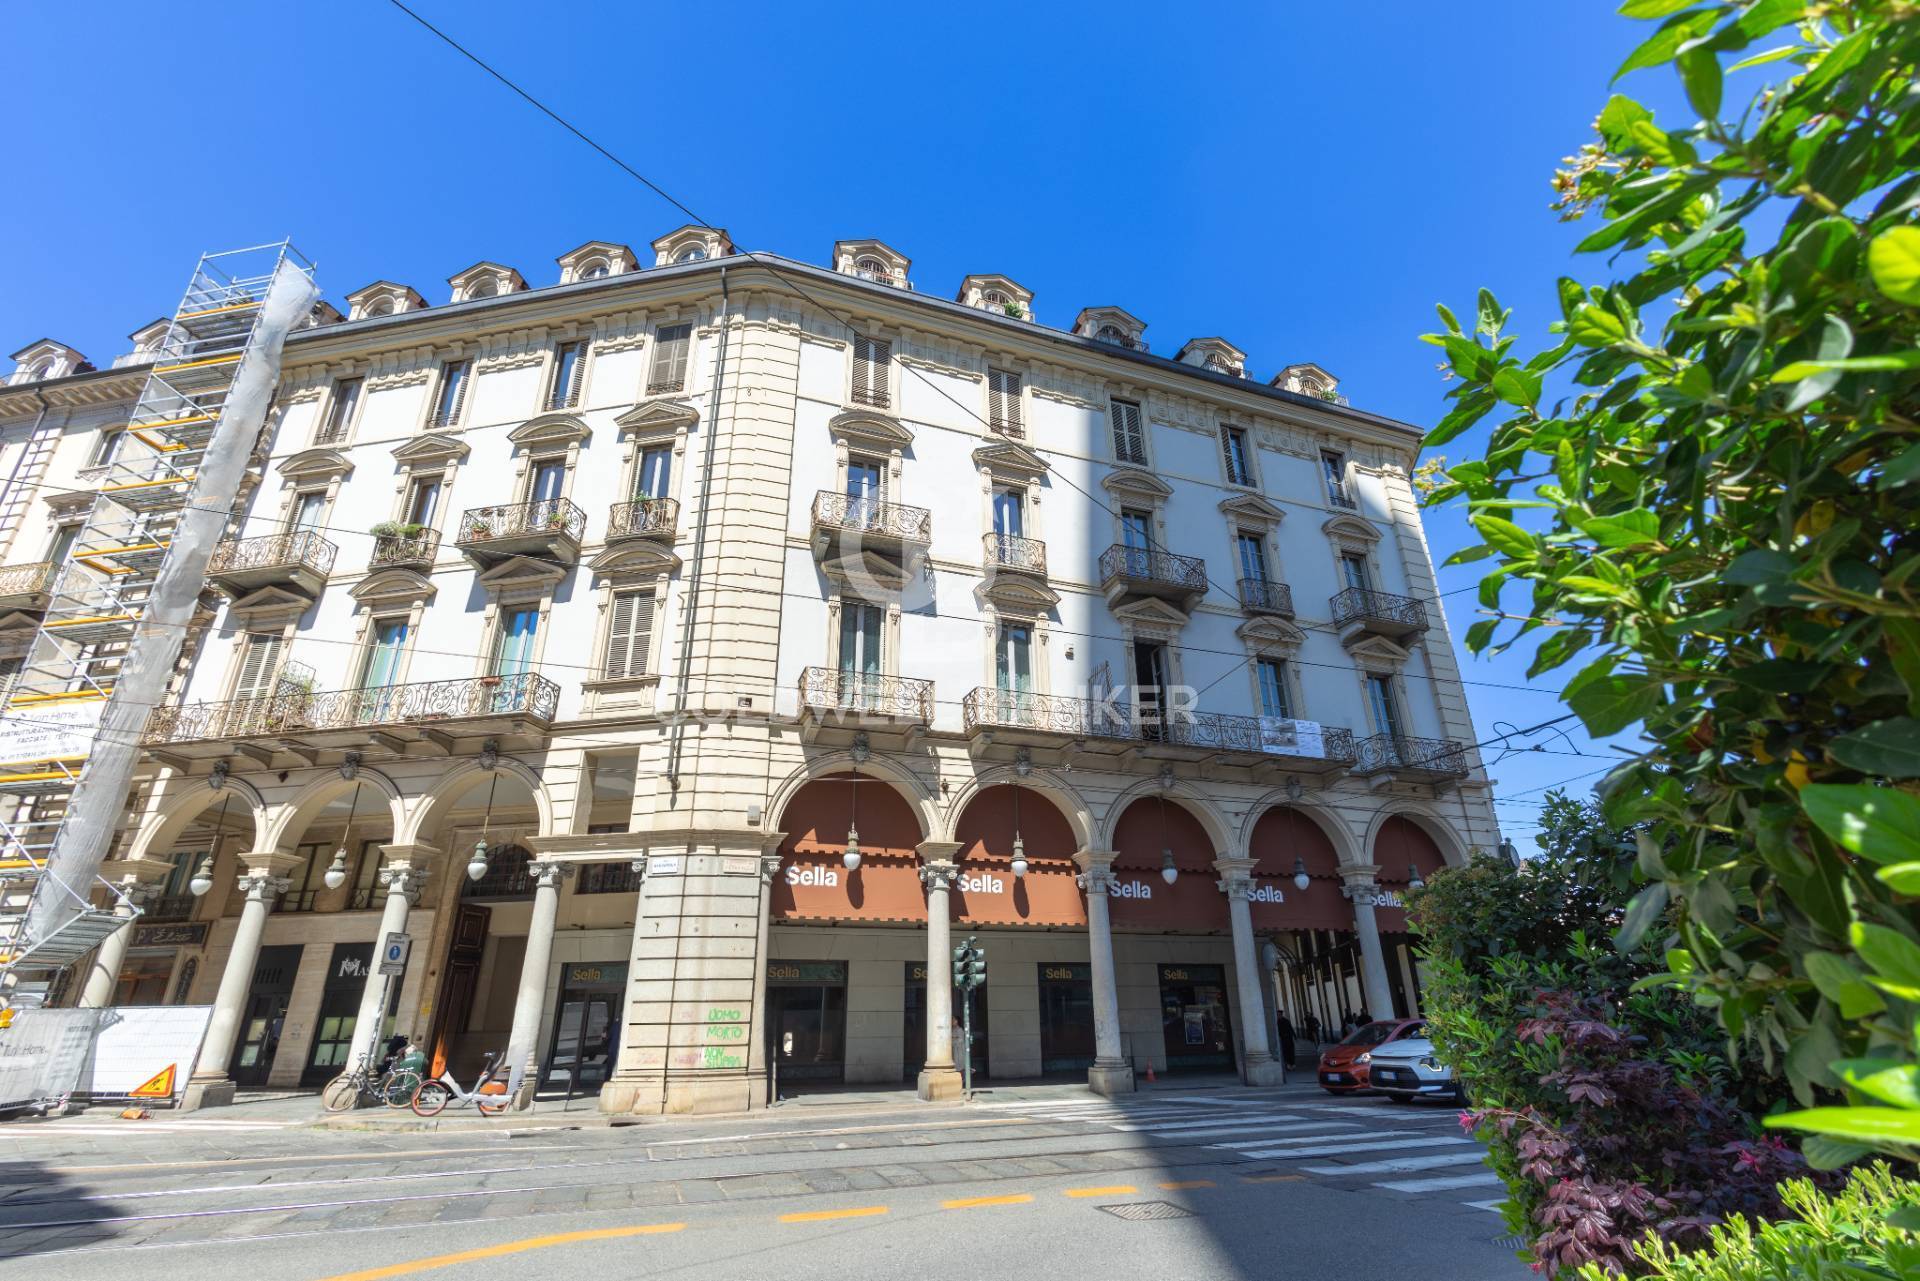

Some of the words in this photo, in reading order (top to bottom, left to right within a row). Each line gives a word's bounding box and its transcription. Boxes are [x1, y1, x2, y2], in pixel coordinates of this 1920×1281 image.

[785, 866, 838, 887] Sella
[957, 873, 1003, 893] Sella
[1110, 880, 1152, 899] Sella
[1247, 885, 1284, 903] Sella
[572, 968, 601, 981] Sella
[768, 966, 800, 978] Sella
[1046, 968, 1073, 979] Sella
[1164, 969, 1188, 980] Sella
[708, 1007, 742, 1021] UOMO
[707, 1026, 743, 1040] MORTO
